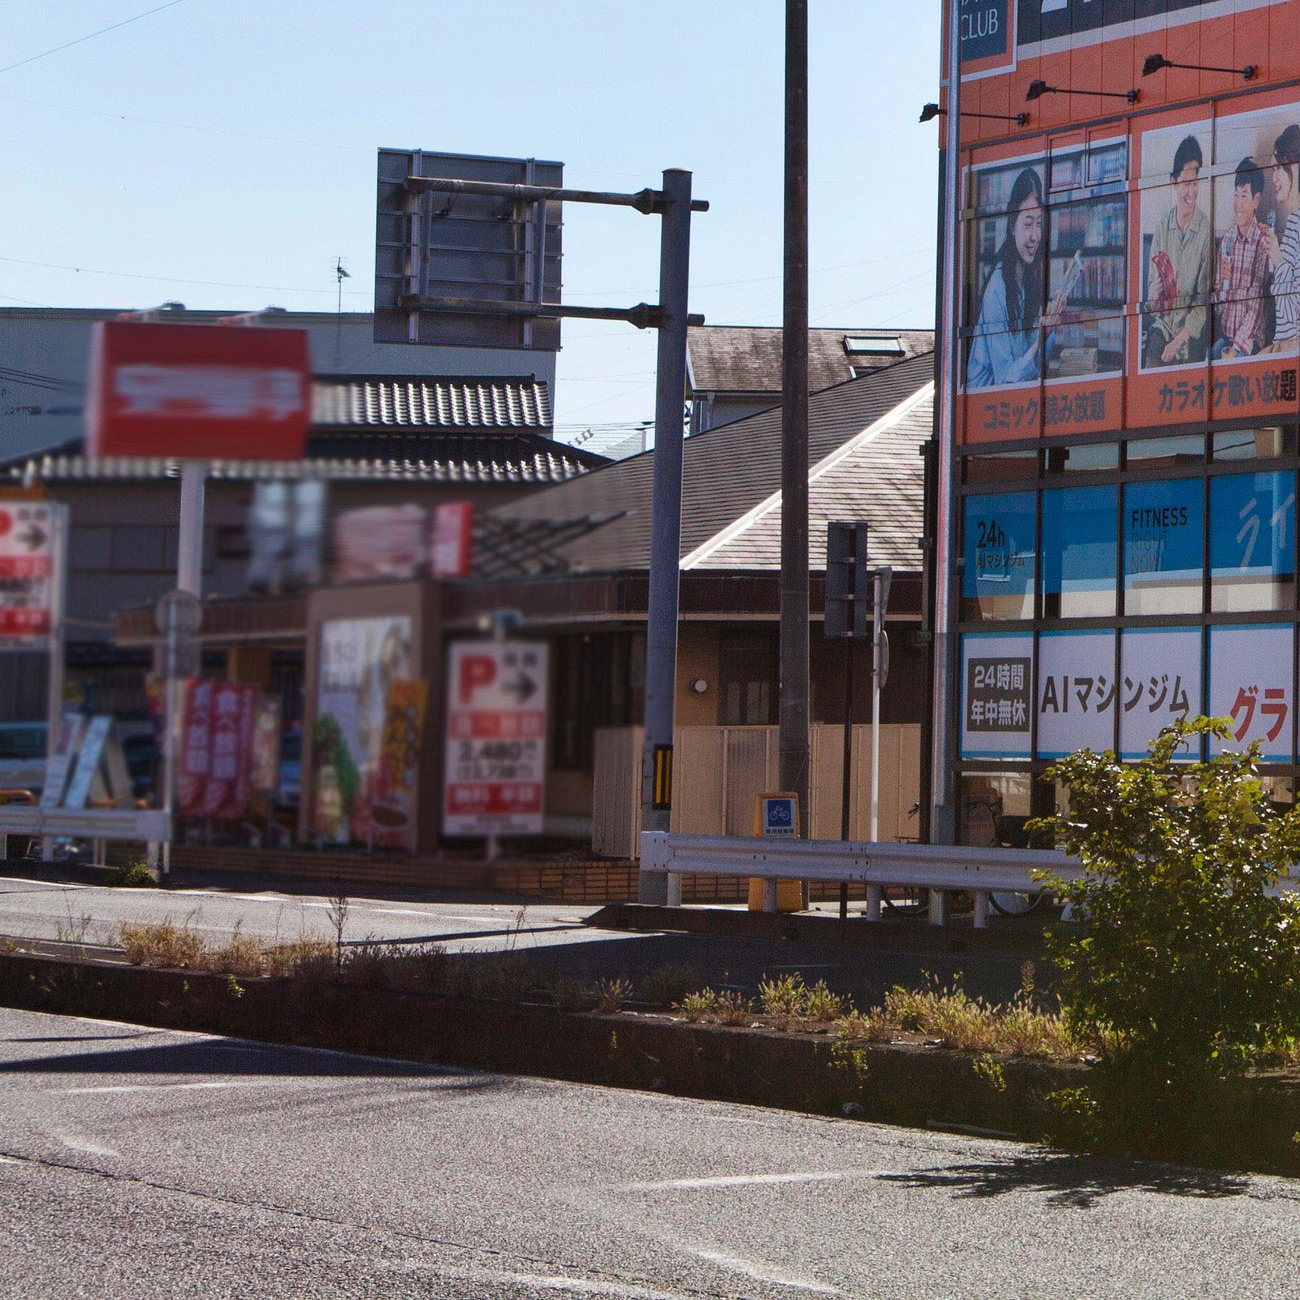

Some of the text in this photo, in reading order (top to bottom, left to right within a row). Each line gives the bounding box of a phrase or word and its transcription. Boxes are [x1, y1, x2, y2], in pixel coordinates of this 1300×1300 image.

[960, 9, 998, 41] CLUB
[1131, 507, 1187, 529] FITNESS
[977, 520, 1005, 548] 24h
[973, 663, 1024, 692] 24時間
[1040, 674, 1190, 714] AIマシンジム
[971, 698, 1026, 727] 年中無休
